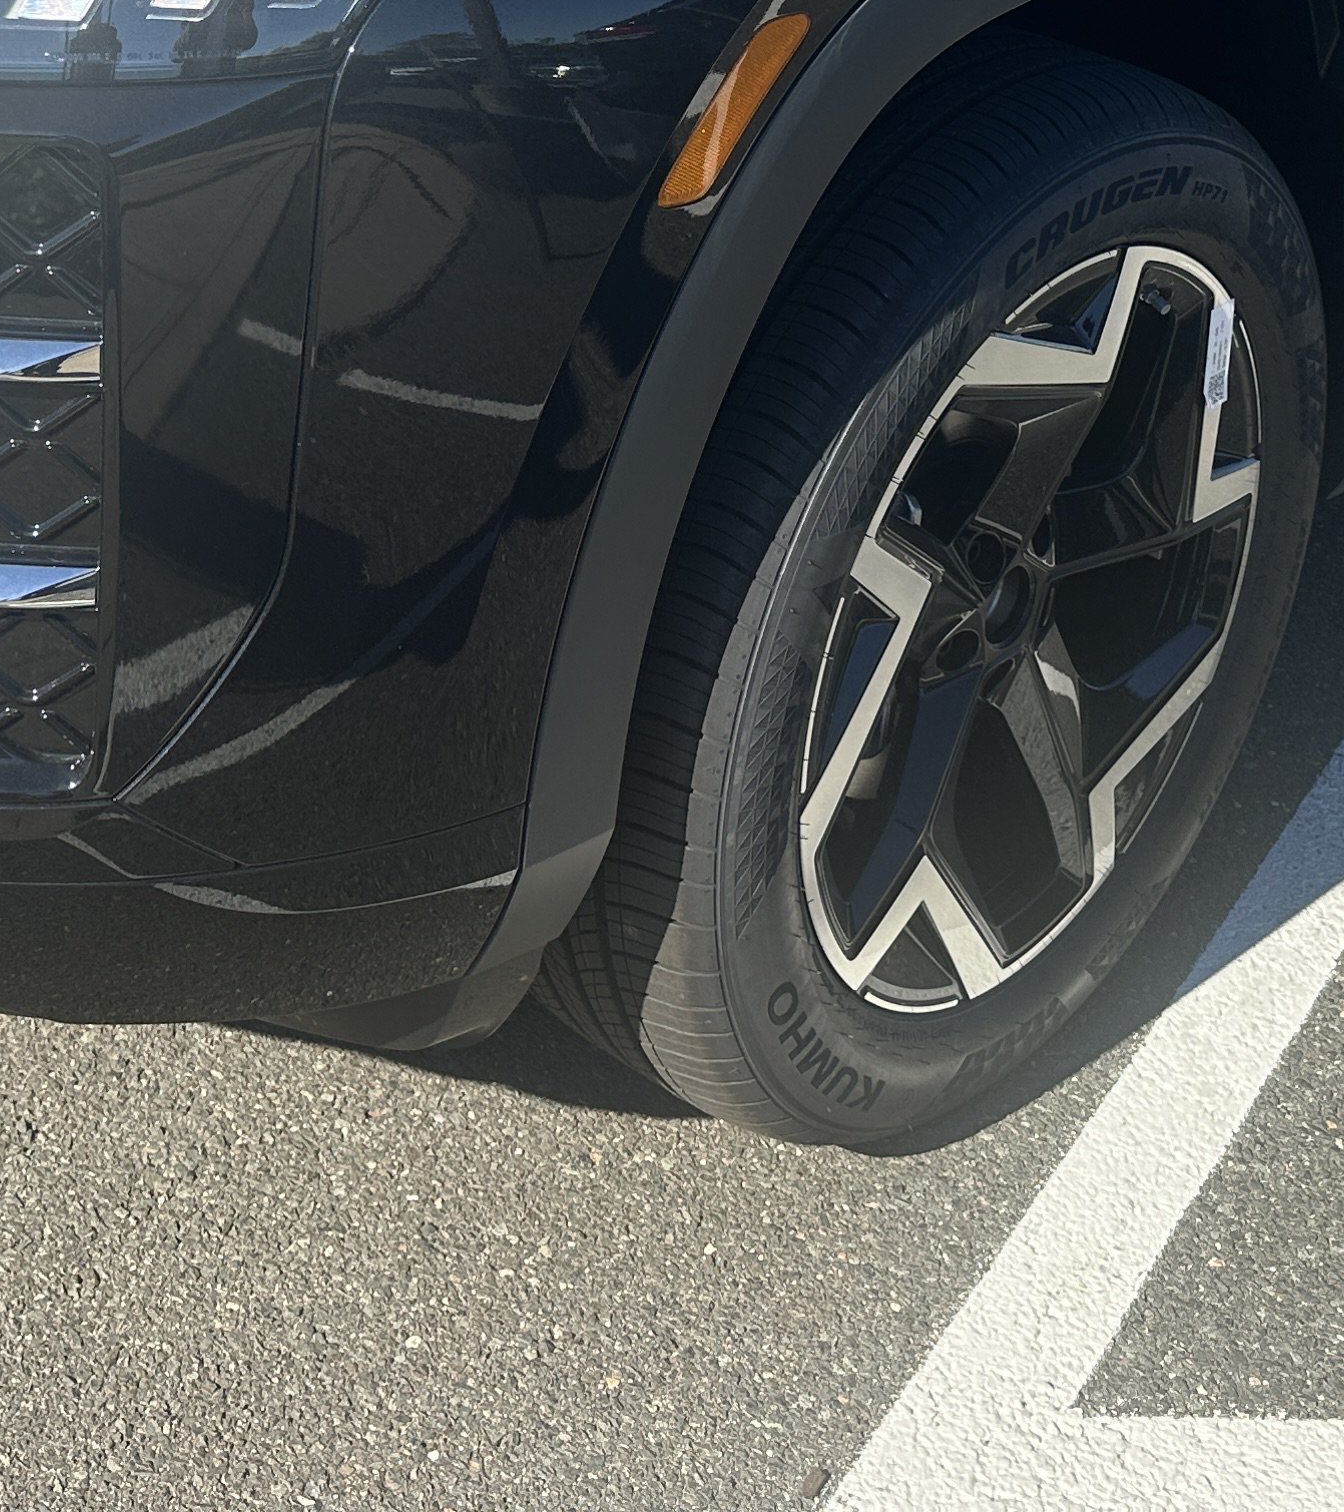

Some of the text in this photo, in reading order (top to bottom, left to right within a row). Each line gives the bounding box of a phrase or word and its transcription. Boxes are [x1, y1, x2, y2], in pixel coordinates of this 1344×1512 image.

[1005, 165, 1228, 291] CRUGEN HP71
[767, 981, 886, 1112] KUMHO
